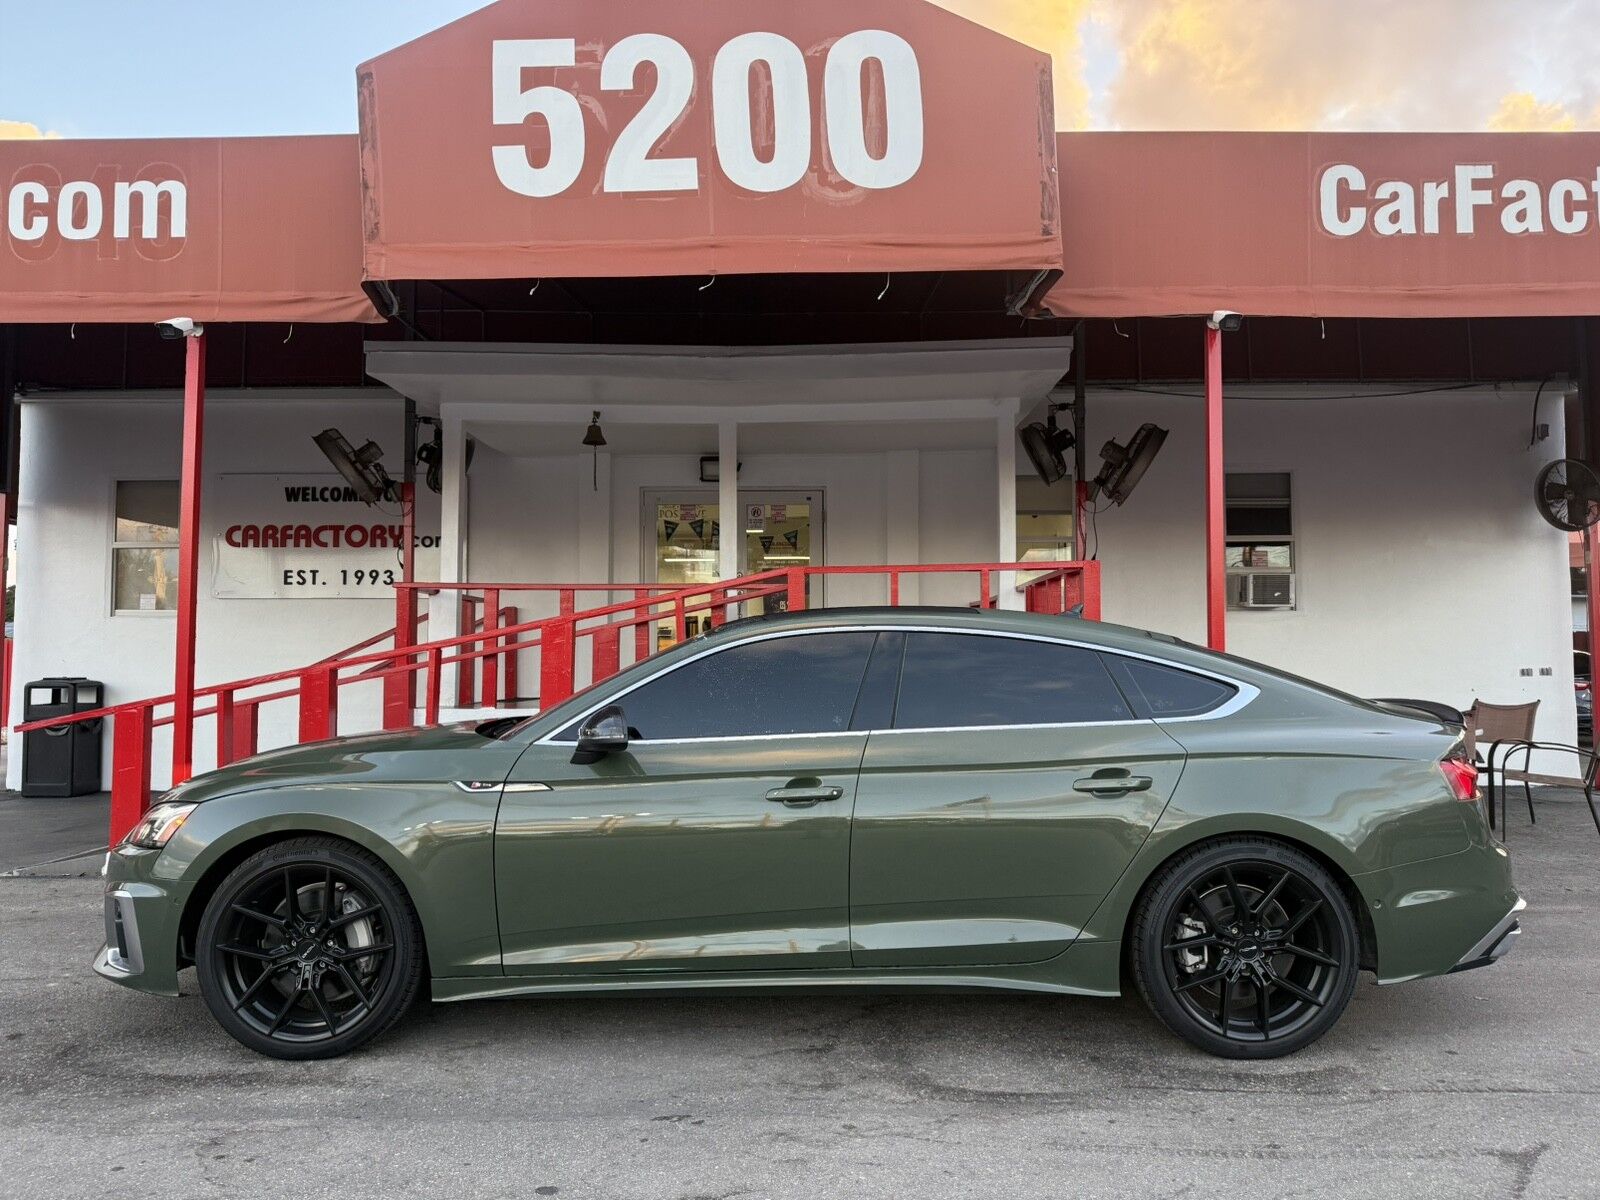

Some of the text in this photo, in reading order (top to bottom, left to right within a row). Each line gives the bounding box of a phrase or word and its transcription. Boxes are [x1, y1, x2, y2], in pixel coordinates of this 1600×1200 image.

[491, 29, 924, 197] 5200
[284, 486, 365, 502] WELCOM
[283, 569, 394, 586] EST. 1993
